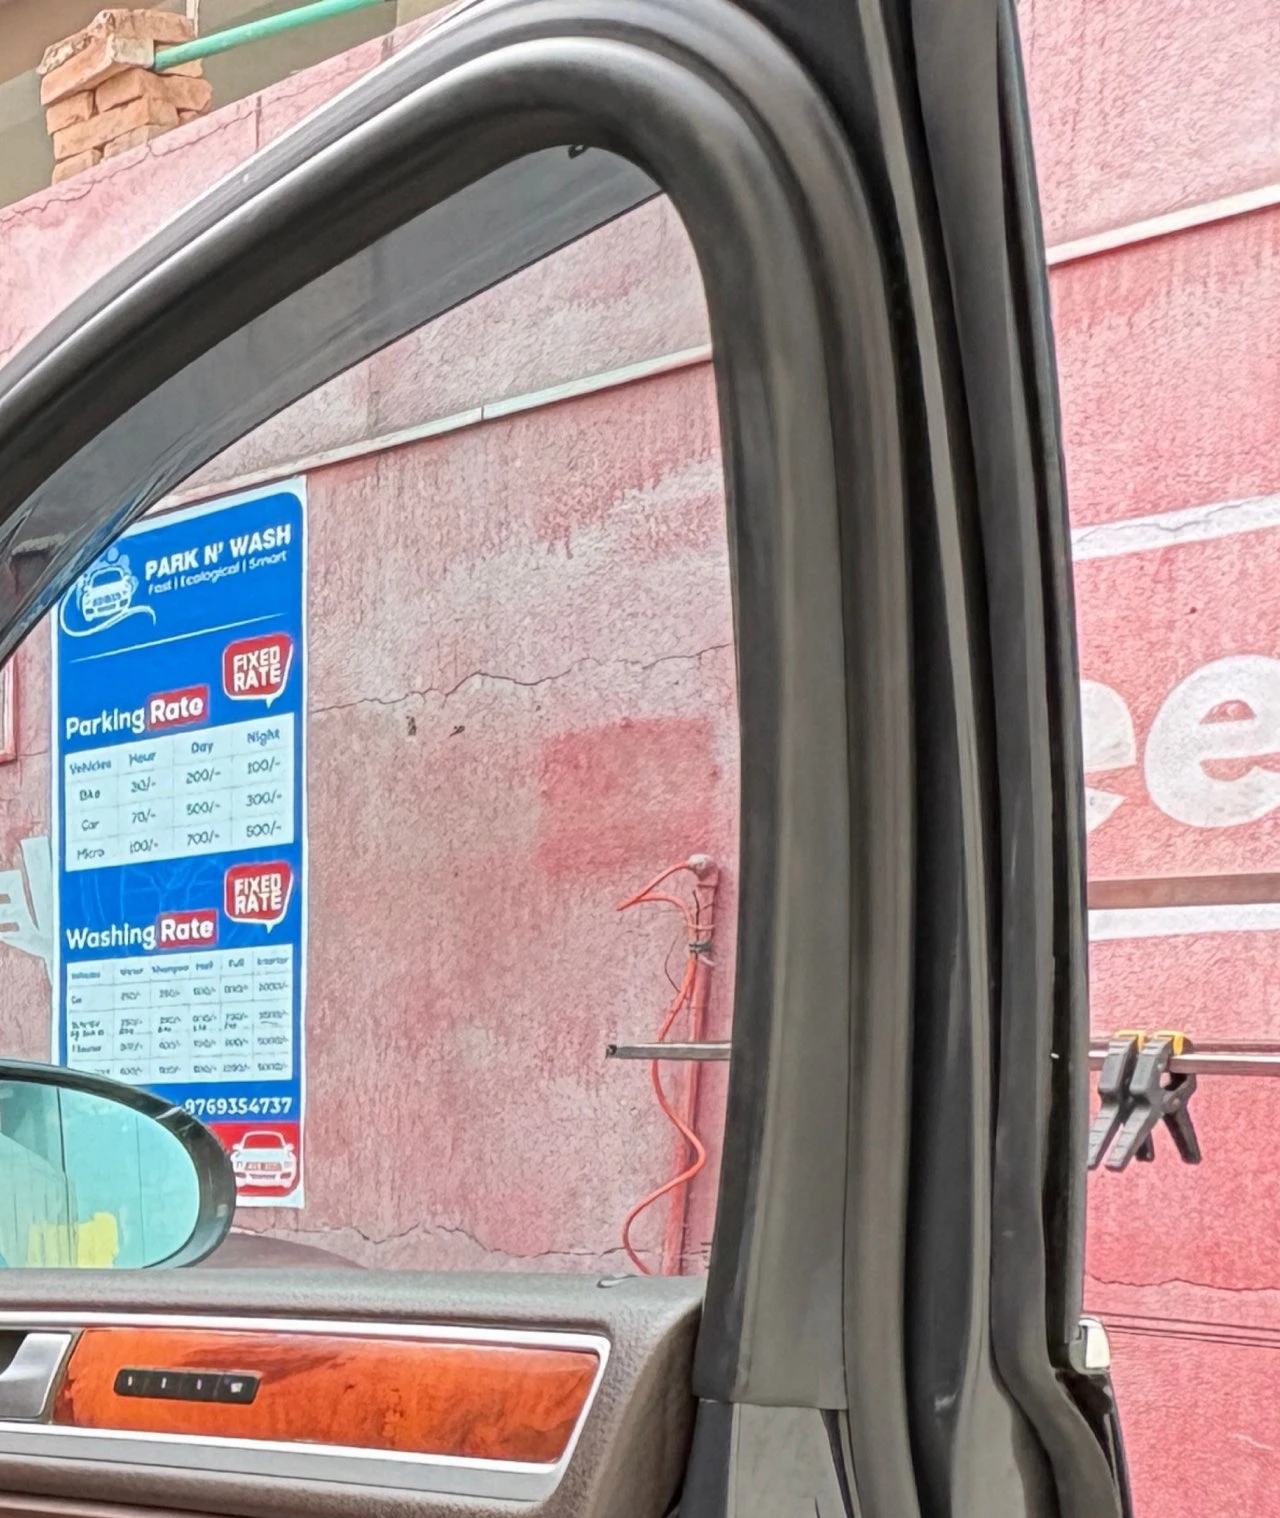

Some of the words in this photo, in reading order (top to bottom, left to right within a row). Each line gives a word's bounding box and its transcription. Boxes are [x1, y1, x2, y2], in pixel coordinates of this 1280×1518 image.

[145, 547, 199, 581] PARK
[204, 541, 224, 566] N'
[229, 523, 292, 559] WASH
[248, 550, 287, 570] Smart
[233, 645, 281, 674] FIXED
[234, 663, 281, 692] RATE
[66, 707, 145, 740] Parking
[150, 696, 204, 724] Rate
[191, 741, 214, 755] Day
[247, 728, 281, 747] Night
[247, 756, 281, 775] 100/-
[81, 818, 100, 832] Car
[131, 808, 157, 825] 70/-
[245, 788, 283, 807] 300/-
[76, 847, 106, 861] Micro
[129, 838, 159, 854] 100/-
[186, 829, 220, 846] 700/-
[246, 820, 282, 838] 500/-
[234, 873, 282, 898] FIXED
[235, 889, 282, 915] RATE
[66, 922, 157, 950] Washing
[160, 918, 214, 942] Rate
[184, 1096, 292, 1115] 9769354737
